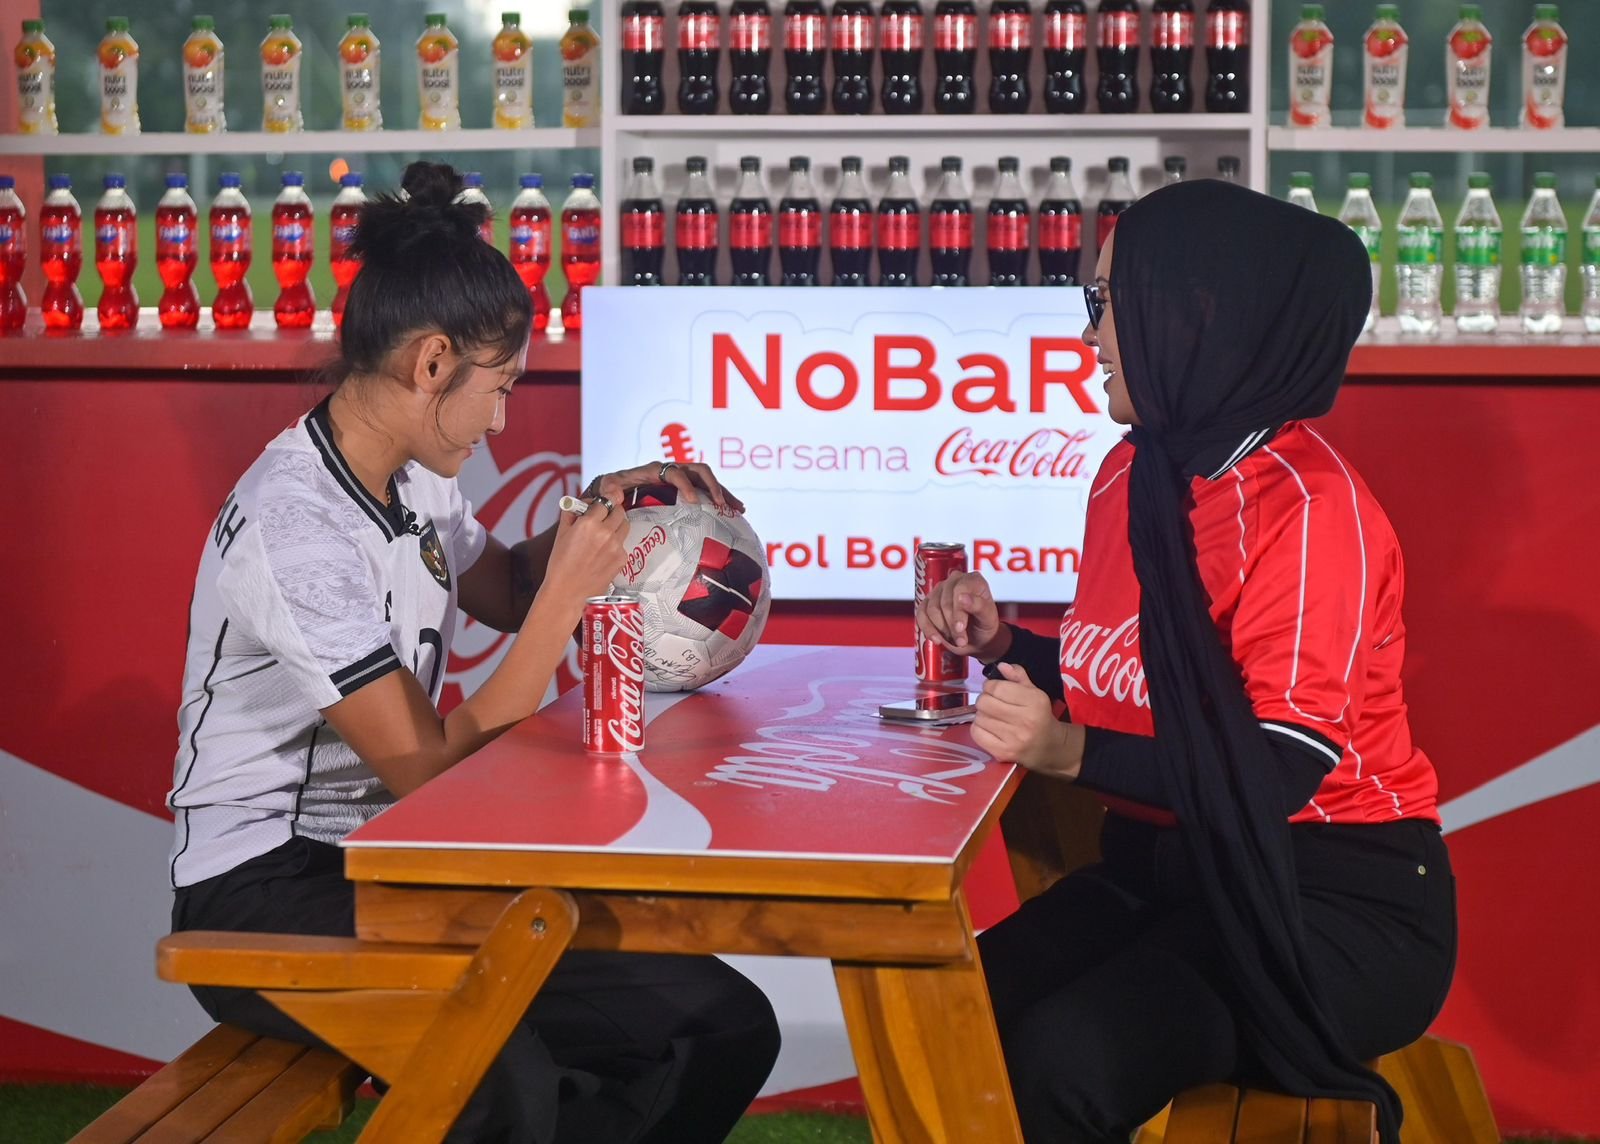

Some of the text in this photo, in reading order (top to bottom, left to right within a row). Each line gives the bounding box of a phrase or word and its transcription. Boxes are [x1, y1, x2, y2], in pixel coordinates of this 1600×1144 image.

[711, 332, 1102, 414] NoBaR
[719, 426, 1097, 478] Bersama Coca-Cola
[973, 539, 1080, 573] Ram
[607, 604, 645, 751] Coca-Cola
